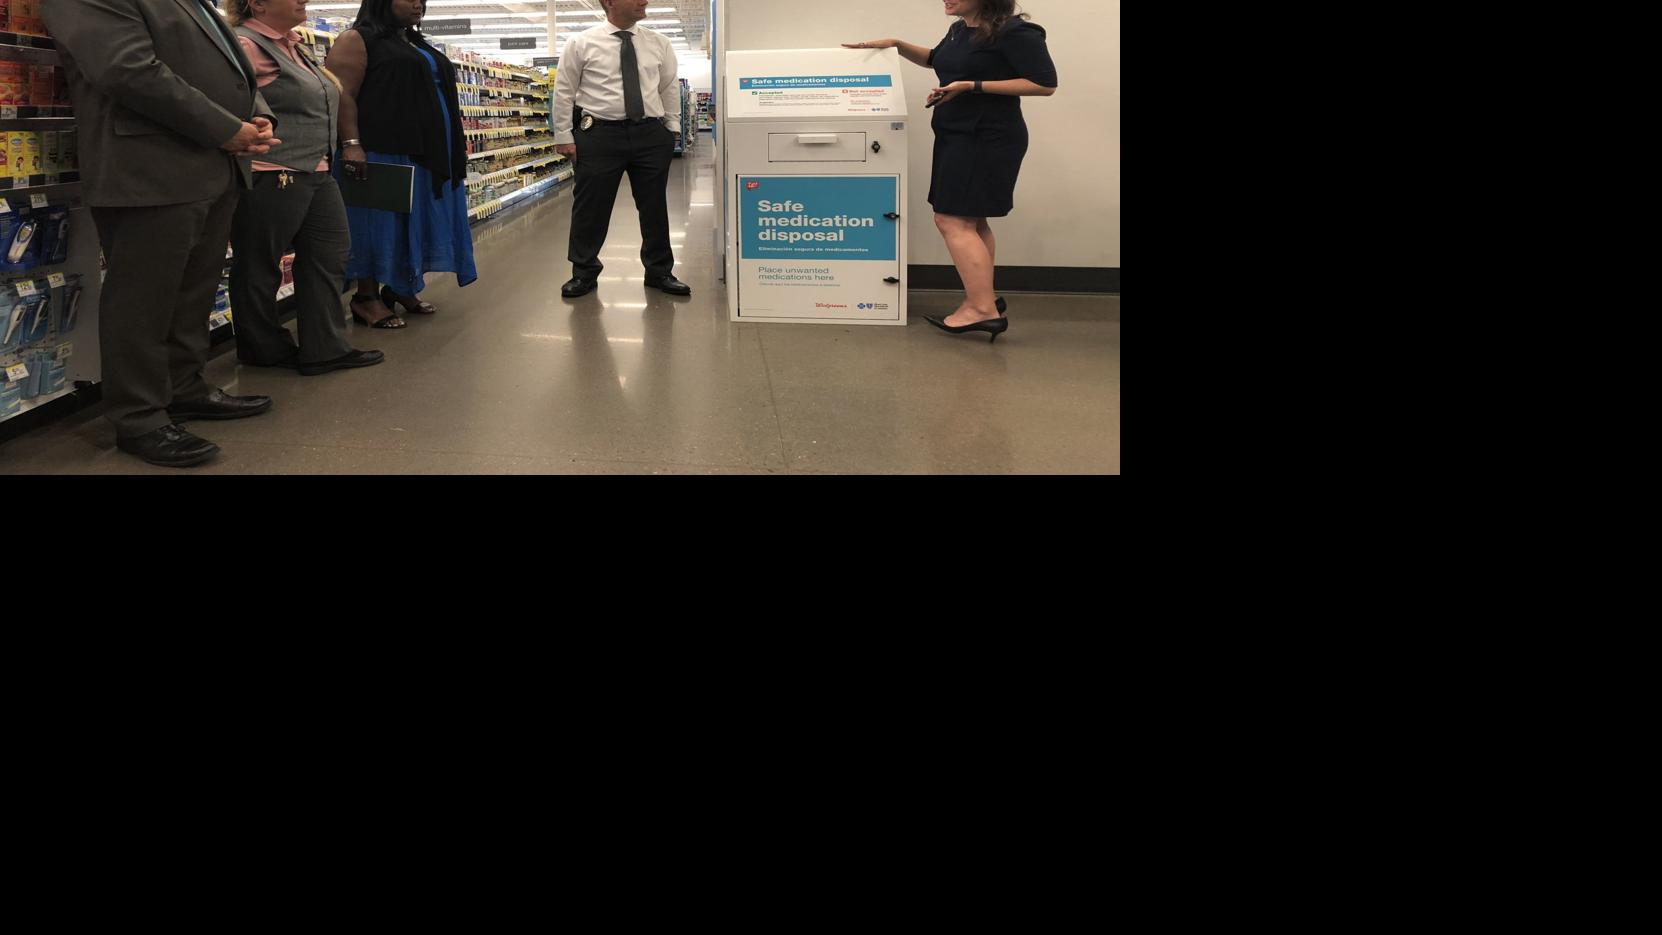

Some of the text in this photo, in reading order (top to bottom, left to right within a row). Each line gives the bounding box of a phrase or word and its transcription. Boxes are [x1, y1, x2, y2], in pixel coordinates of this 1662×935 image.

[424, 24, 468, 32] multi-vitamins
[829, 76, 869, 84] disposal
[757, 200, 804, 213] Safe
[758, 215, 874, 227] medication
[758, 229, 844, 243] disposal
[758, 266, 829, 275] Place unwanted
[758, 273, 812, 281] medications
